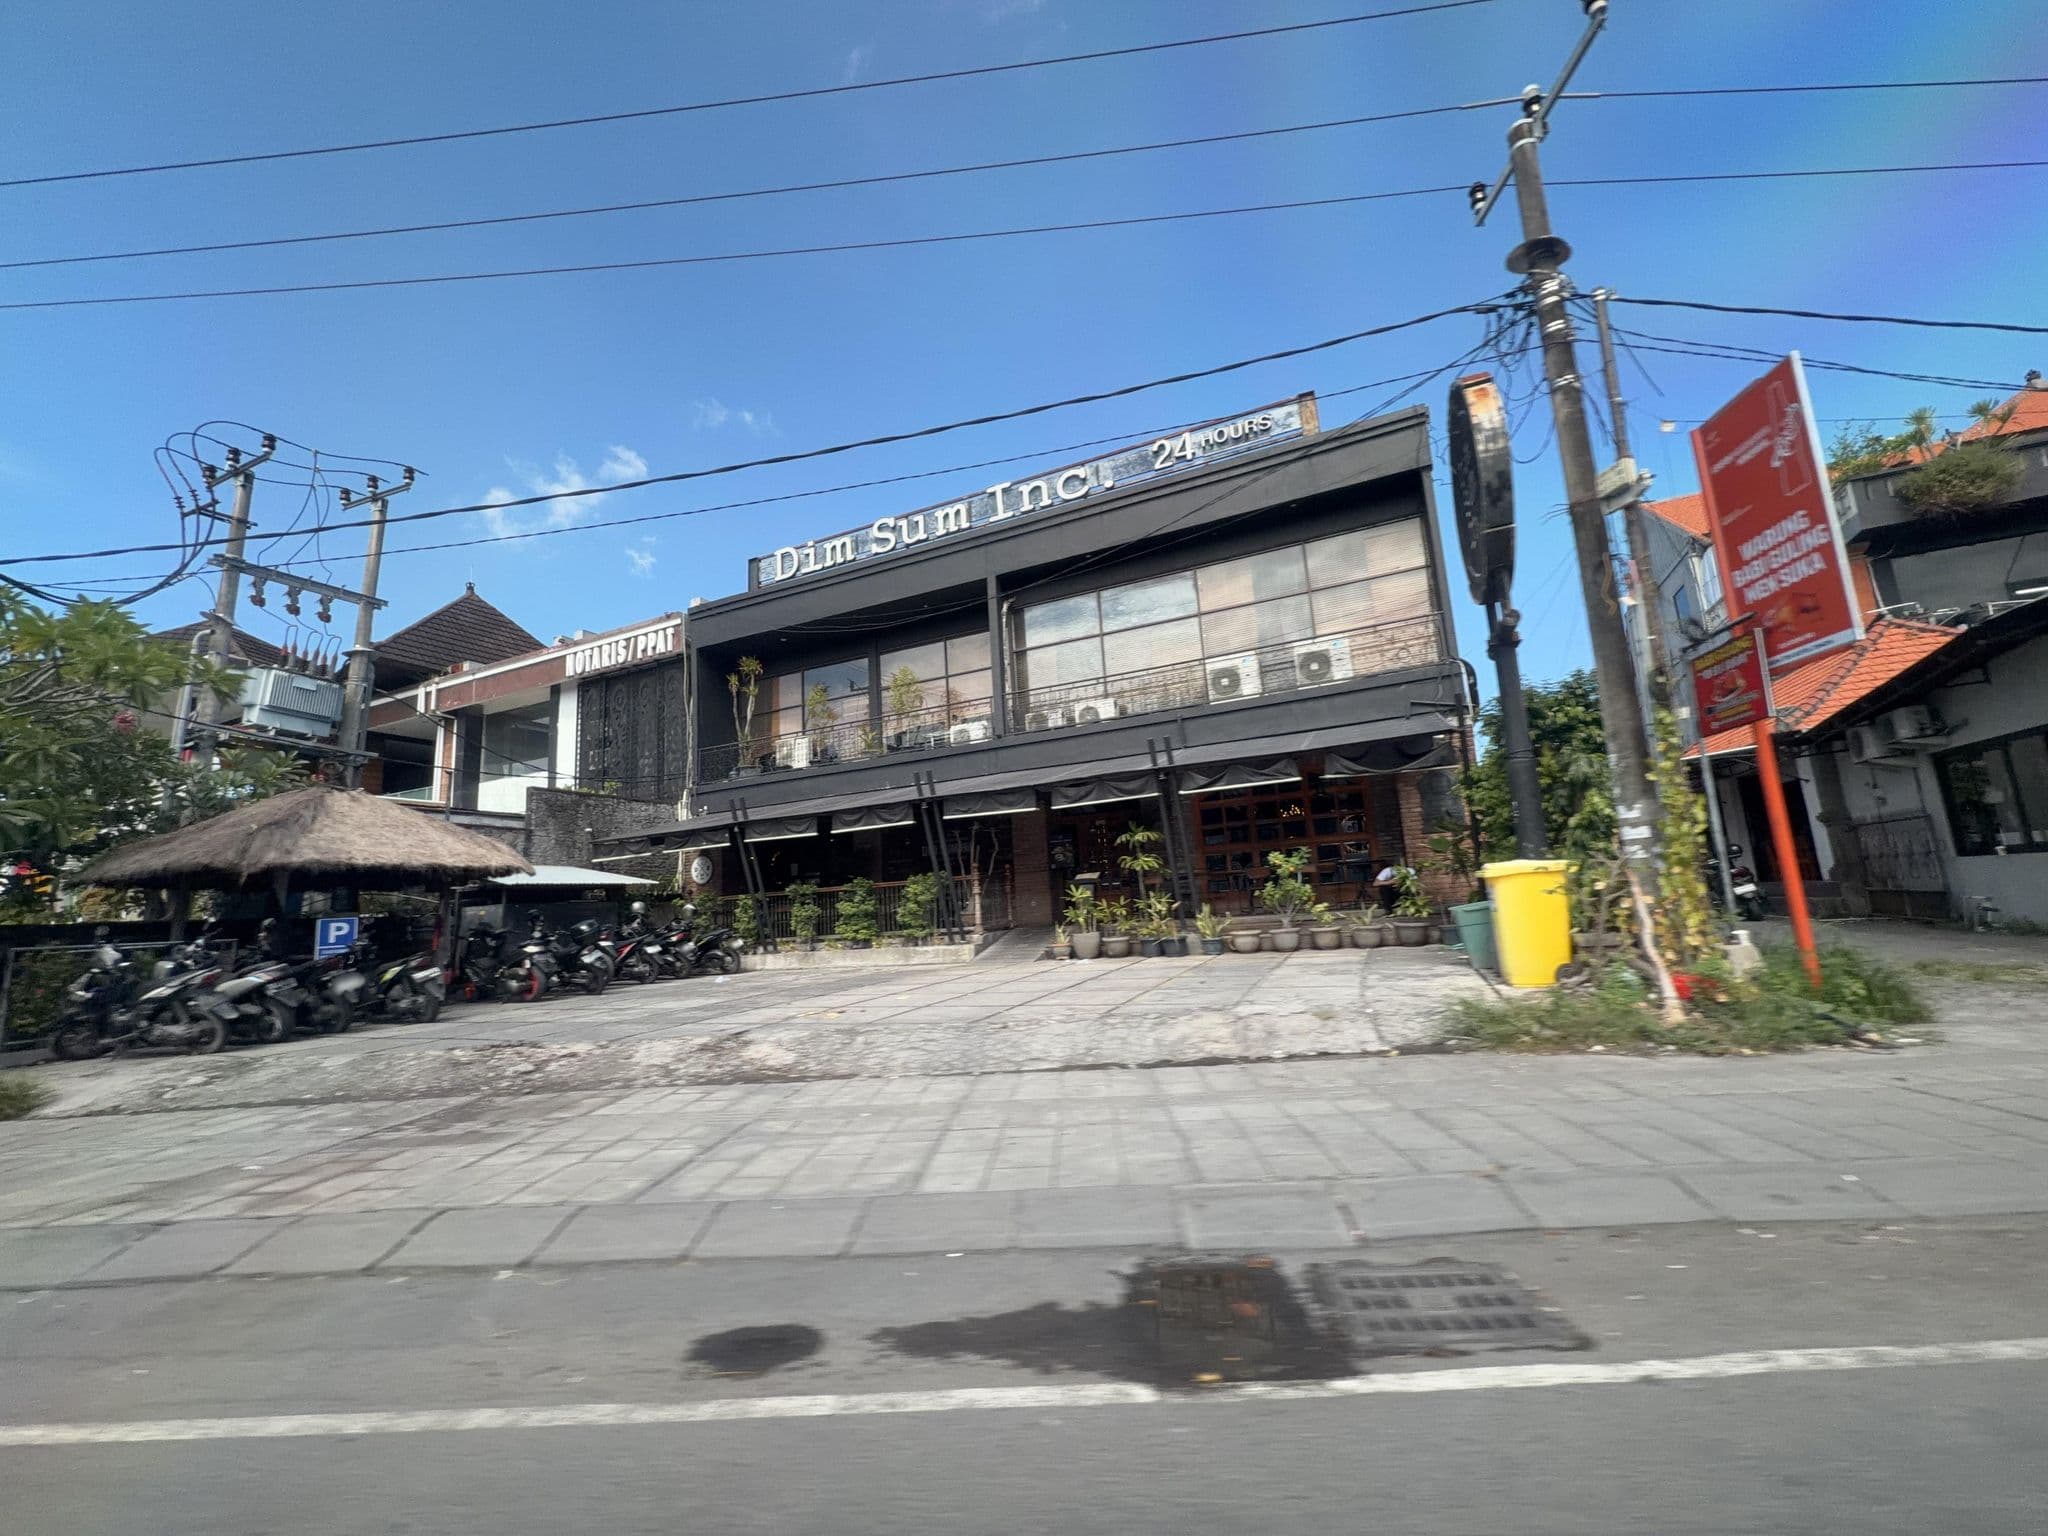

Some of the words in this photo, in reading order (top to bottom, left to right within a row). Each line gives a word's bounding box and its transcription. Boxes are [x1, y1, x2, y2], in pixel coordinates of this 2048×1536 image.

[1152, 431, 1196, 470] 24
[1200, 415, 1272, 448] HOURS
[774, 535, 855, 581] Dim
[871, 502, 970, 555] Sum
[986, 465, 1115, 522] Inc.
[565, 627, 675, 677] NOTARIS/PPAT
[328, 922, 350, 943] P
